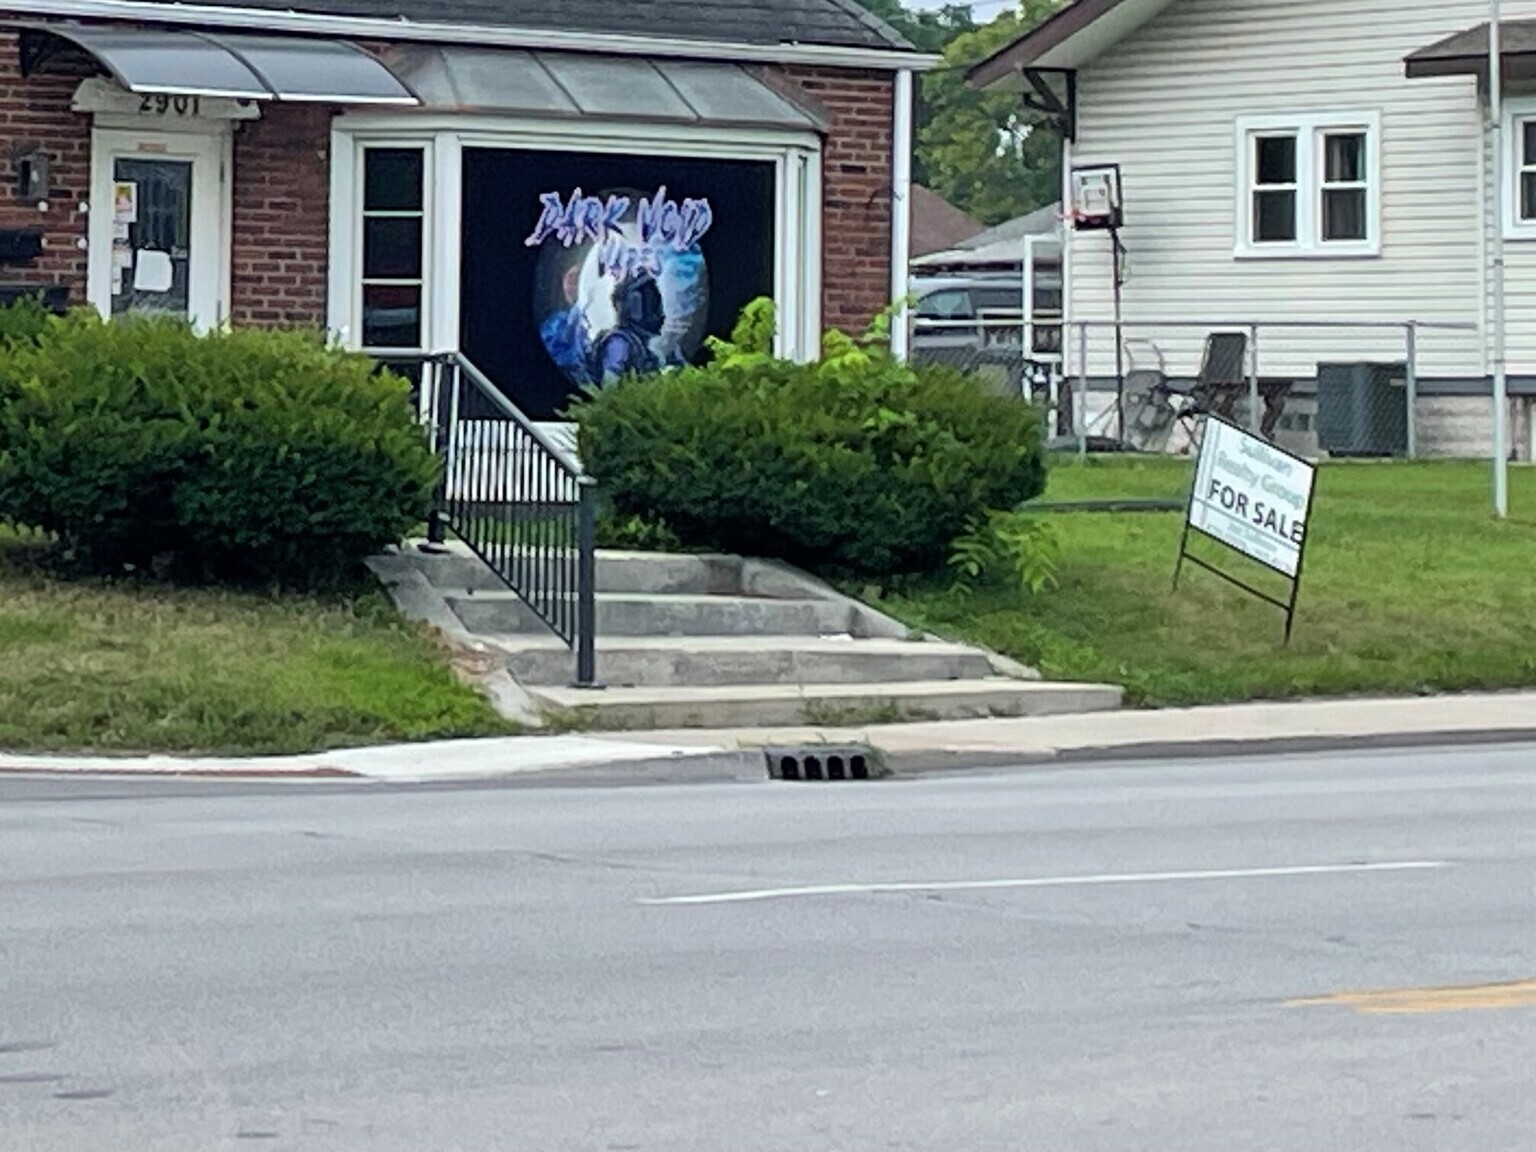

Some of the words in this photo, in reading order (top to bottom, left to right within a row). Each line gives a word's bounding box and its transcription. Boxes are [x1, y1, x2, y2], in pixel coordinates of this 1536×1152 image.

[139, 93, 199, 115] 2901
[1208, 478, 1249, 519] FOR
[1252, 501, 1305, 545] SALE
